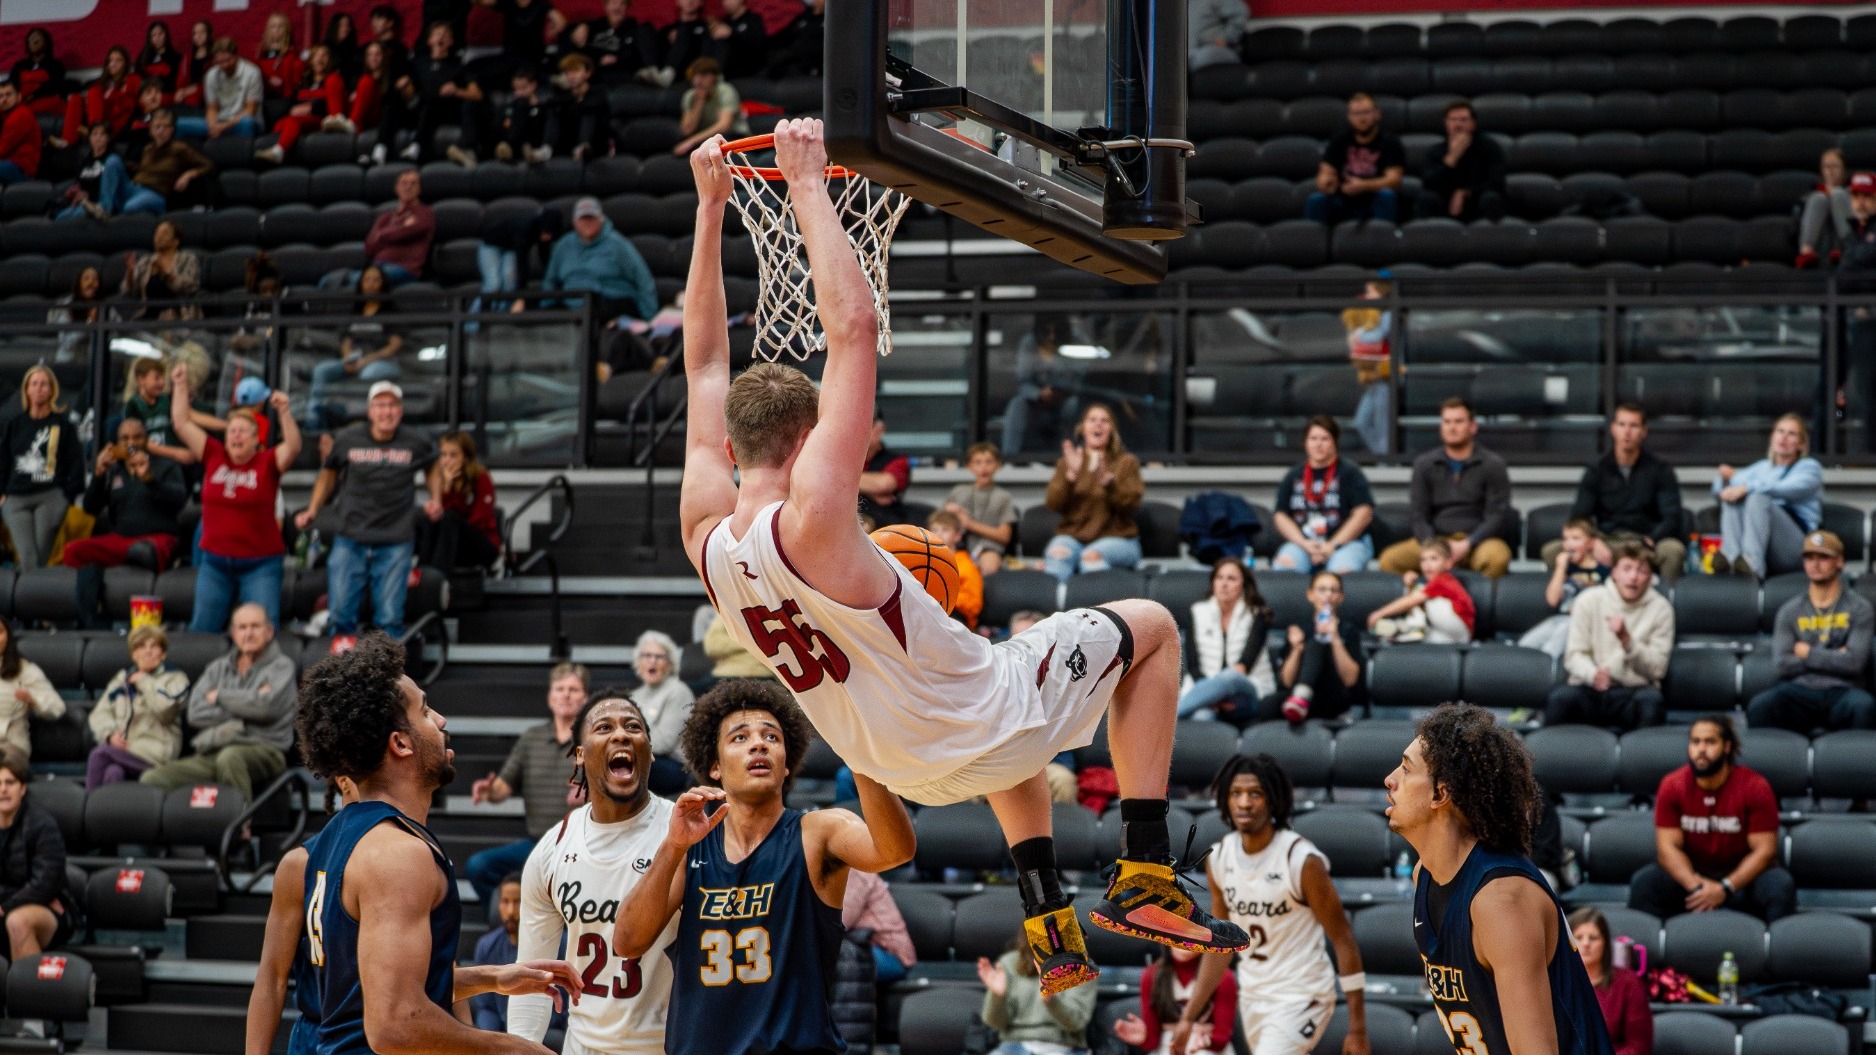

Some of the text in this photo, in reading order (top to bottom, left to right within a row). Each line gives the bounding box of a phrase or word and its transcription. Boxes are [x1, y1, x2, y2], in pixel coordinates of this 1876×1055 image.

[636, 858, 655, 869] SA
[558, 880, 621, 924] Bea
[698, 882, 775, 920] E&H
[1225, 886, 1292, 918] Bears
[576, 932, 643, 999] 23
[700, 925, 772, 987] 33
